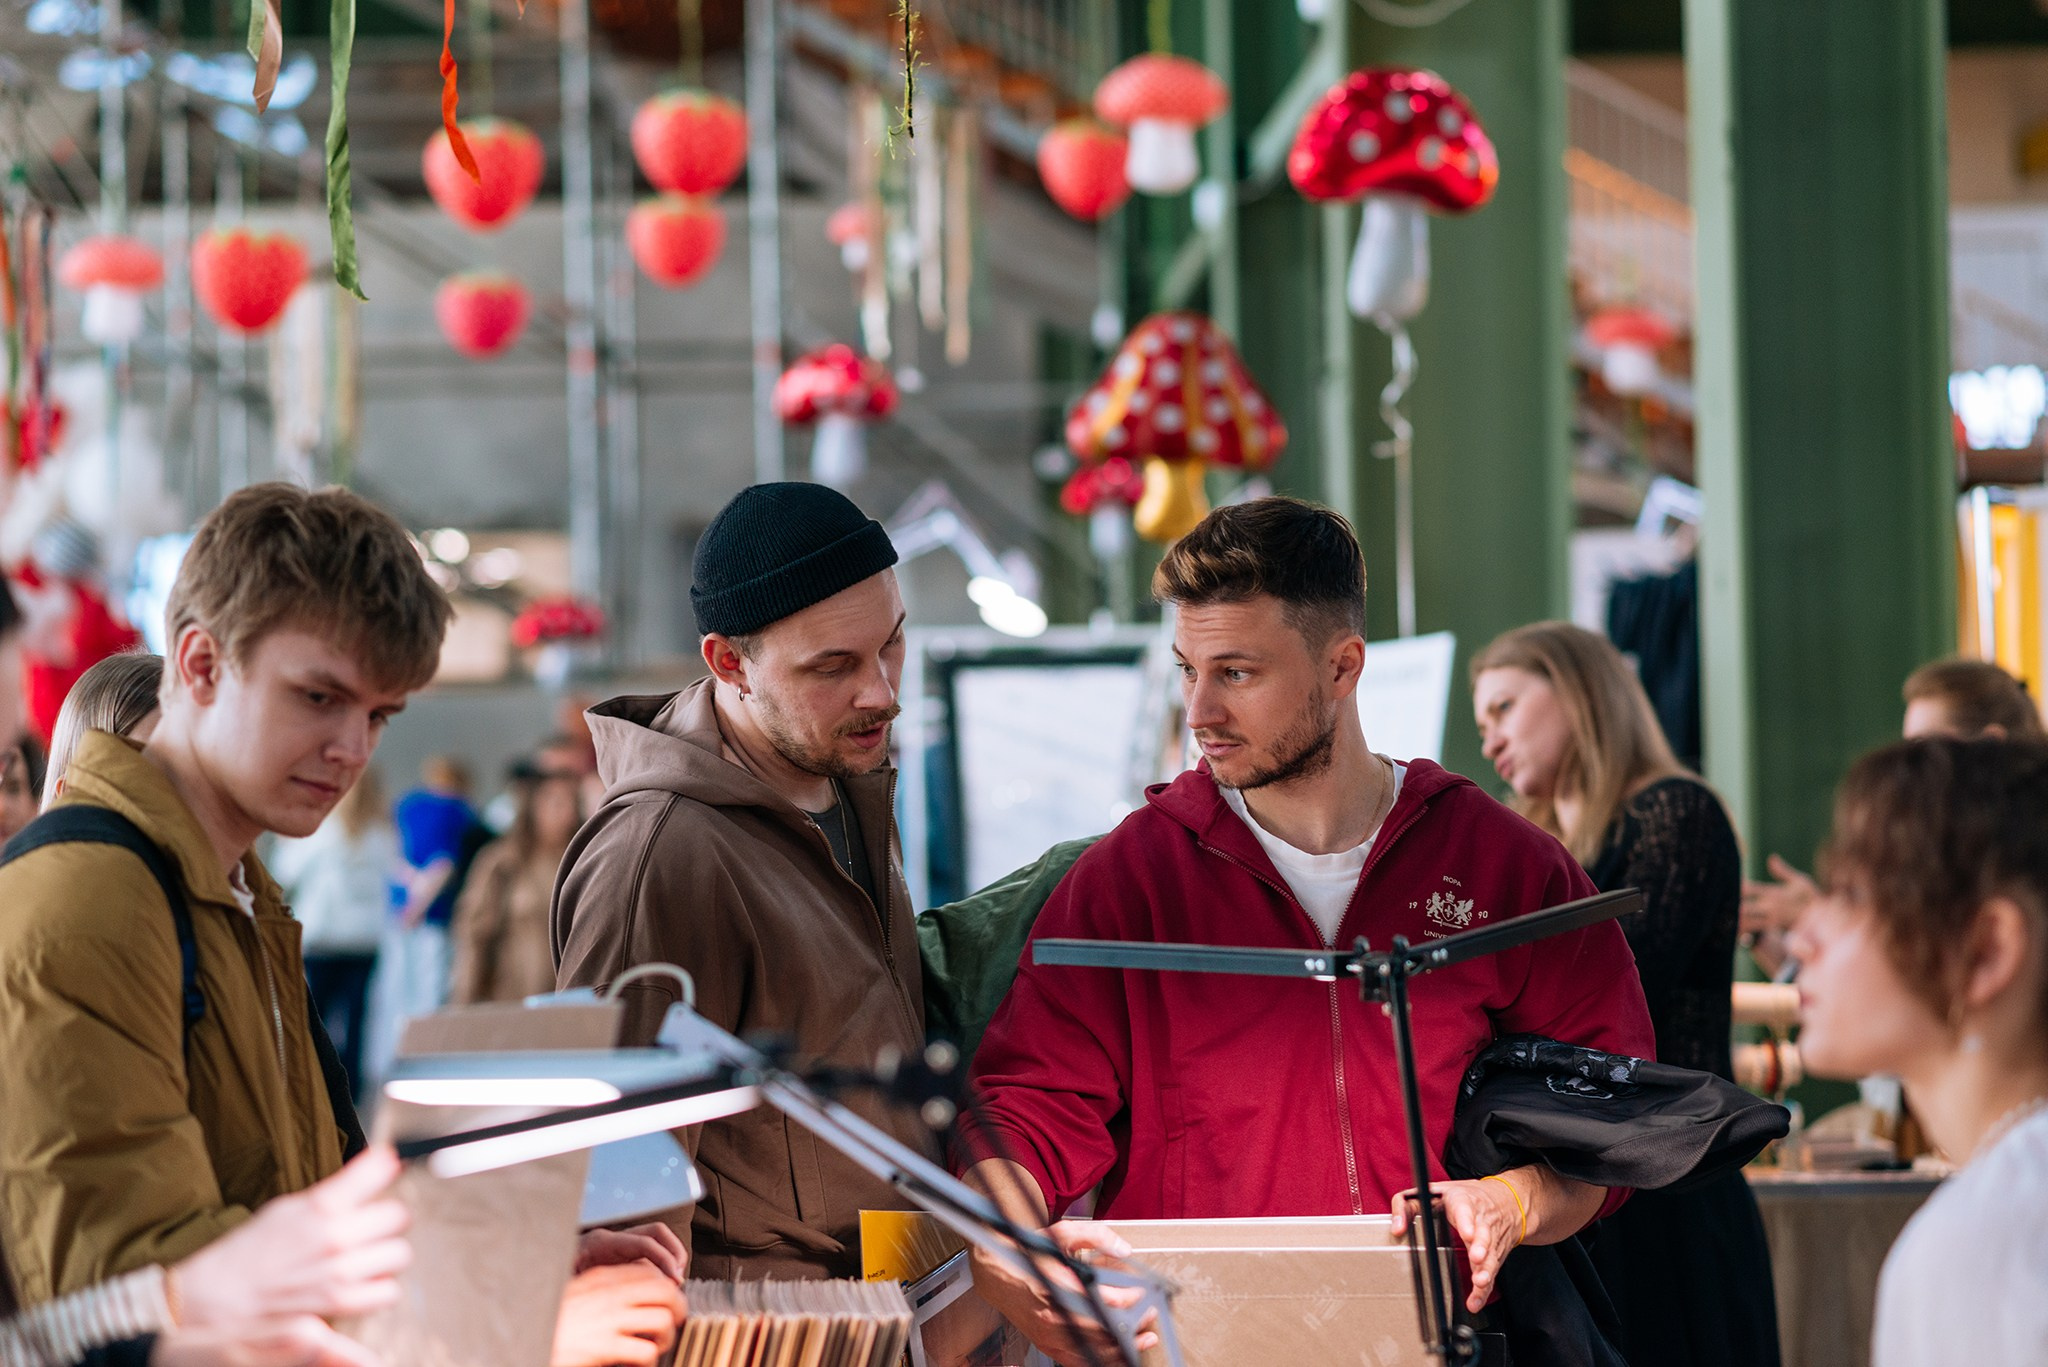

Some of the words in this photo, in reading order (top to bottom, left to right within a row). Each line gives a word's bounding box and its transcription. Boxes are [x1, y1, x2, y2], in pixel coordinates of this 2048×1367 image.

[1443, 875, 1462, 887] ROPA
[1408, 901, 1418, 909] 19
[1477, 911, 1489, 919] 90
[1423, 929, 1449, 939] UNIVE
